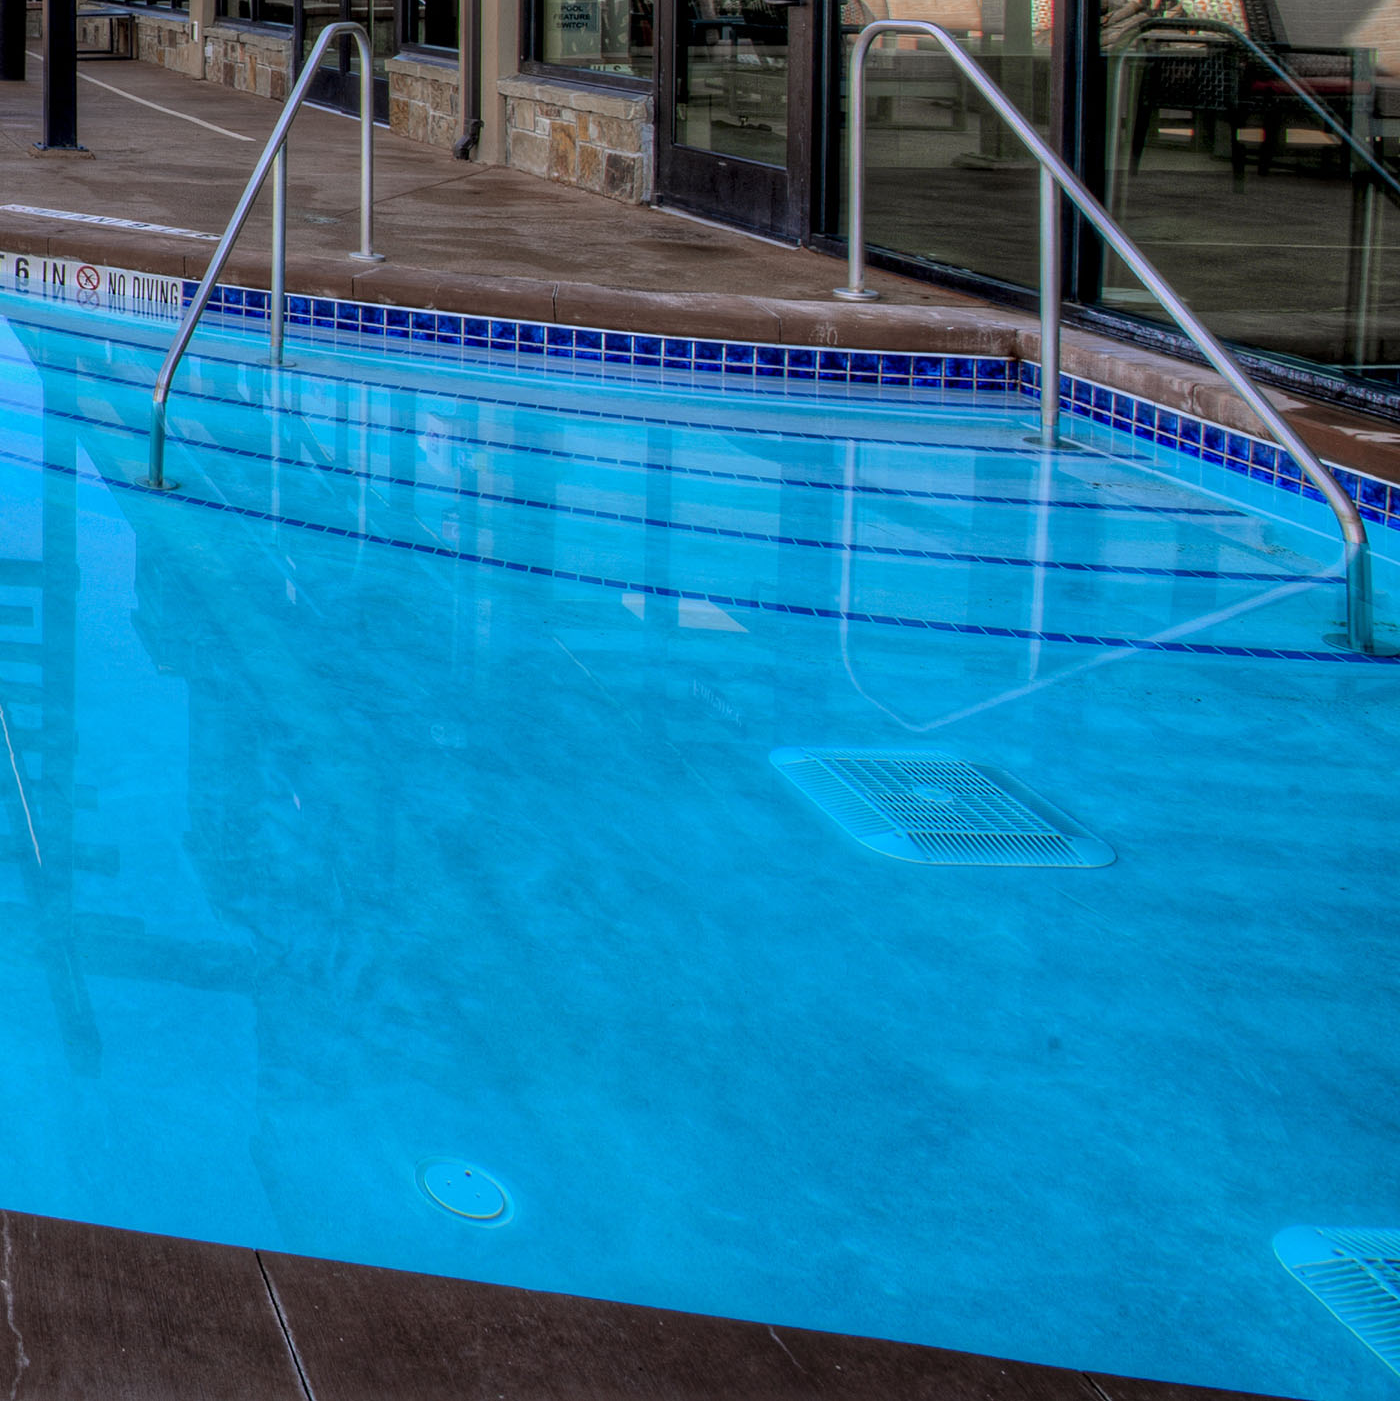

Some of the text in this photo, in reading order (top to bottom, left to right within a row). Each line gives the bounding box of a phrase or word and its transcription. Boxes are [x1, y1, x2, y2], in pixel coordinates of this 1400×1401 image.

[15, 257, 29, 279] 6
[43, 260, 66, 286] IN
[108, 271, 126, 296] NO
[133, 275, 178, 305] DIVING
